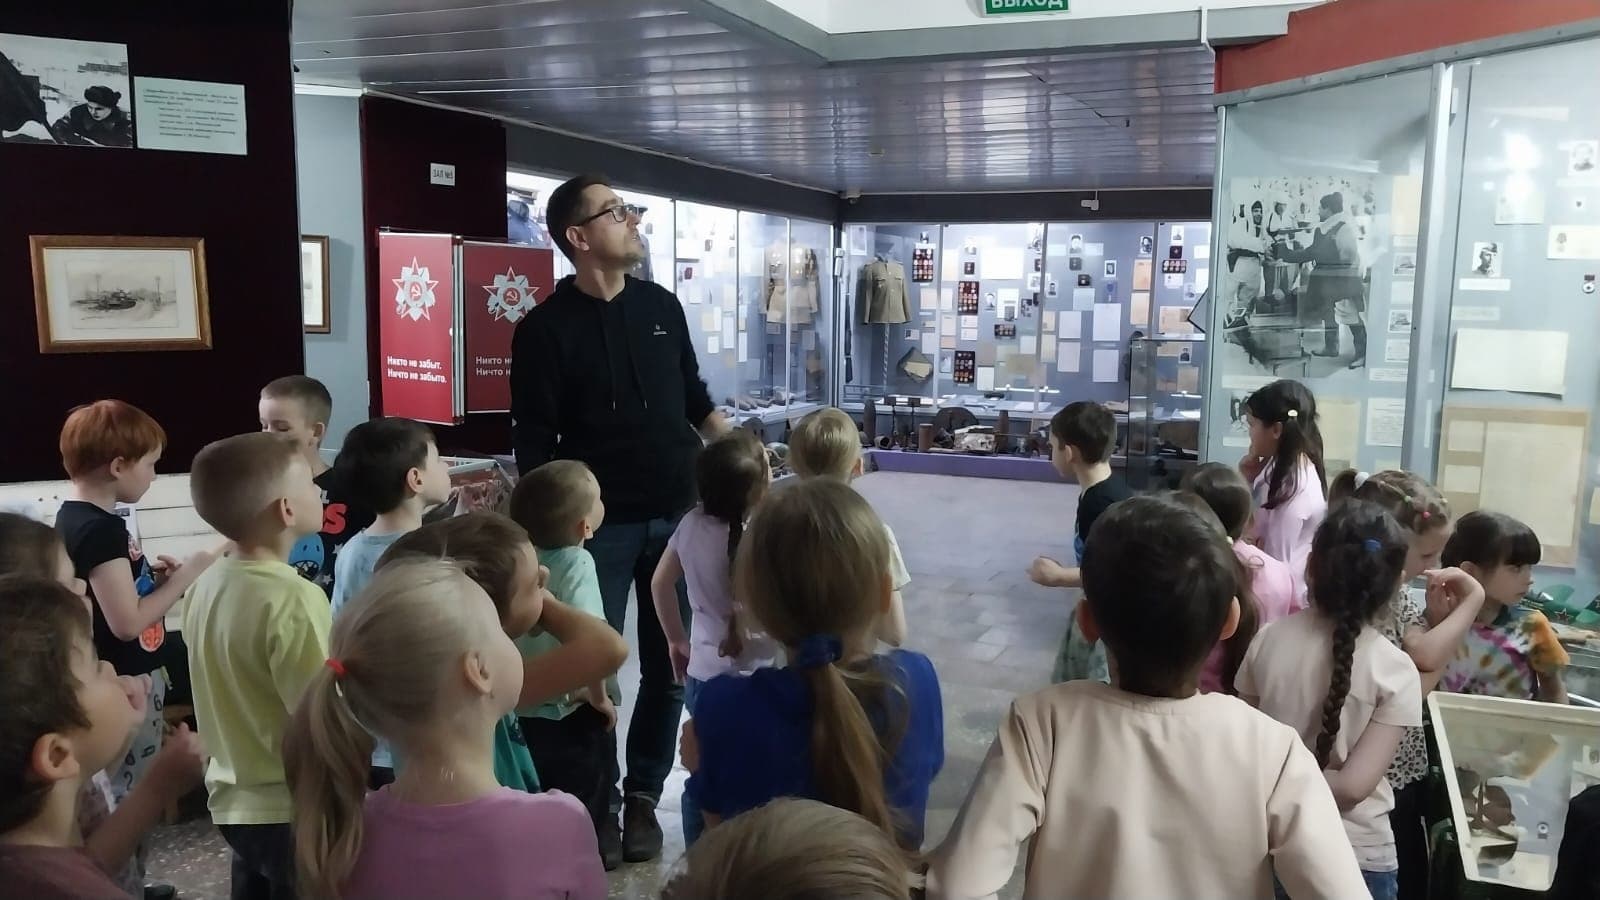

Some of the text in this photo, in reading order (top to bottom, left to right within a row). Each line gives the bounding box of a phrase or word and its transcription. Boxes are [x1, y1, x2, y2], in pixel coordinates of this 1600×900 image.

[991, 0, 1064, 9] ВЫХОД
[387, 355, 442, 370] Никто не забыт.
[475, 356, 503, 365] Никто
[387, 368, 447, 383] Ничто не забыто.
[476, 367, 511, 376] Ничто н
